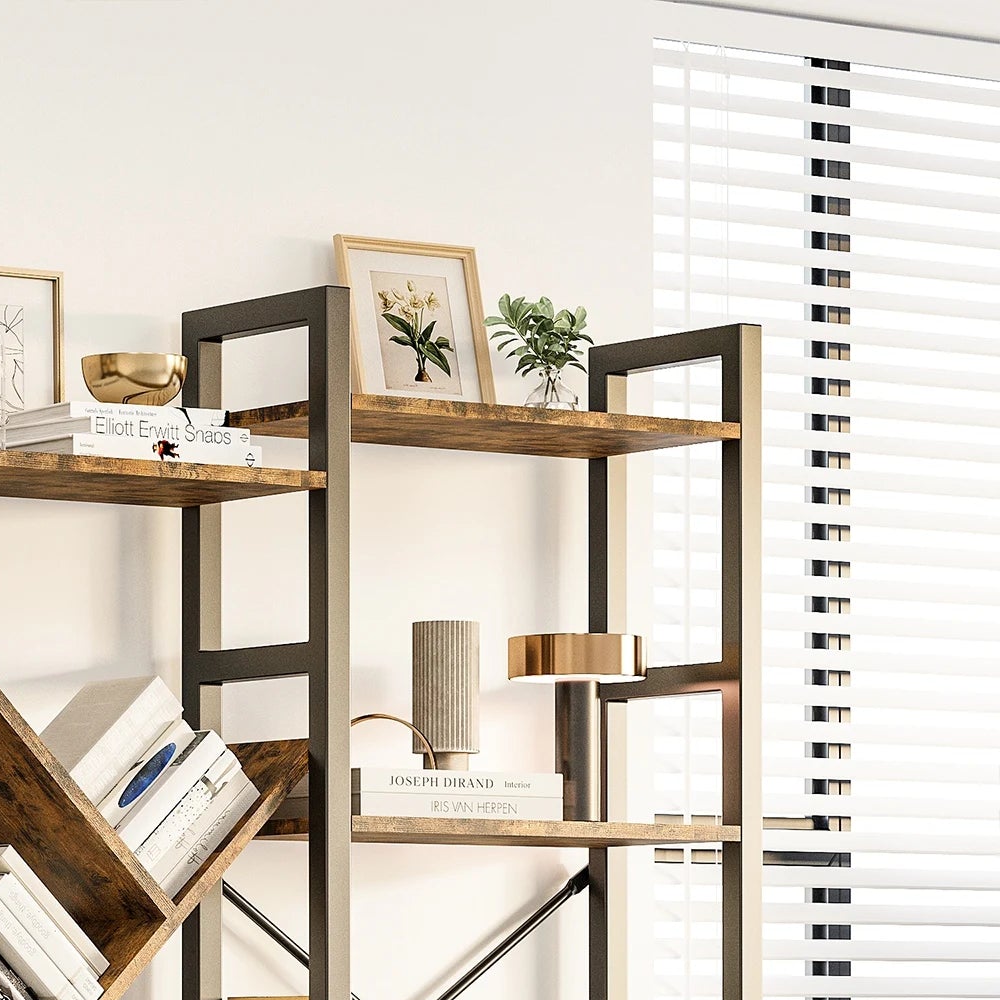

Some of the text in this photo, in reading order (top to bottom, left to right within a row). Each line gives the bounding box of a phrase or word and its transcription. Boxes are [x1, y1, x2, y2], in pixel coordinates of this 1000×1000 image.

[95, 416, 134, 437] Elliott
[139, 420, 180, 441] Erwitt
[388, 775, 531, 789] JOSEPH DIRAND Interior
[430, 800, 517, 814] IRIS VAN HERPEN
